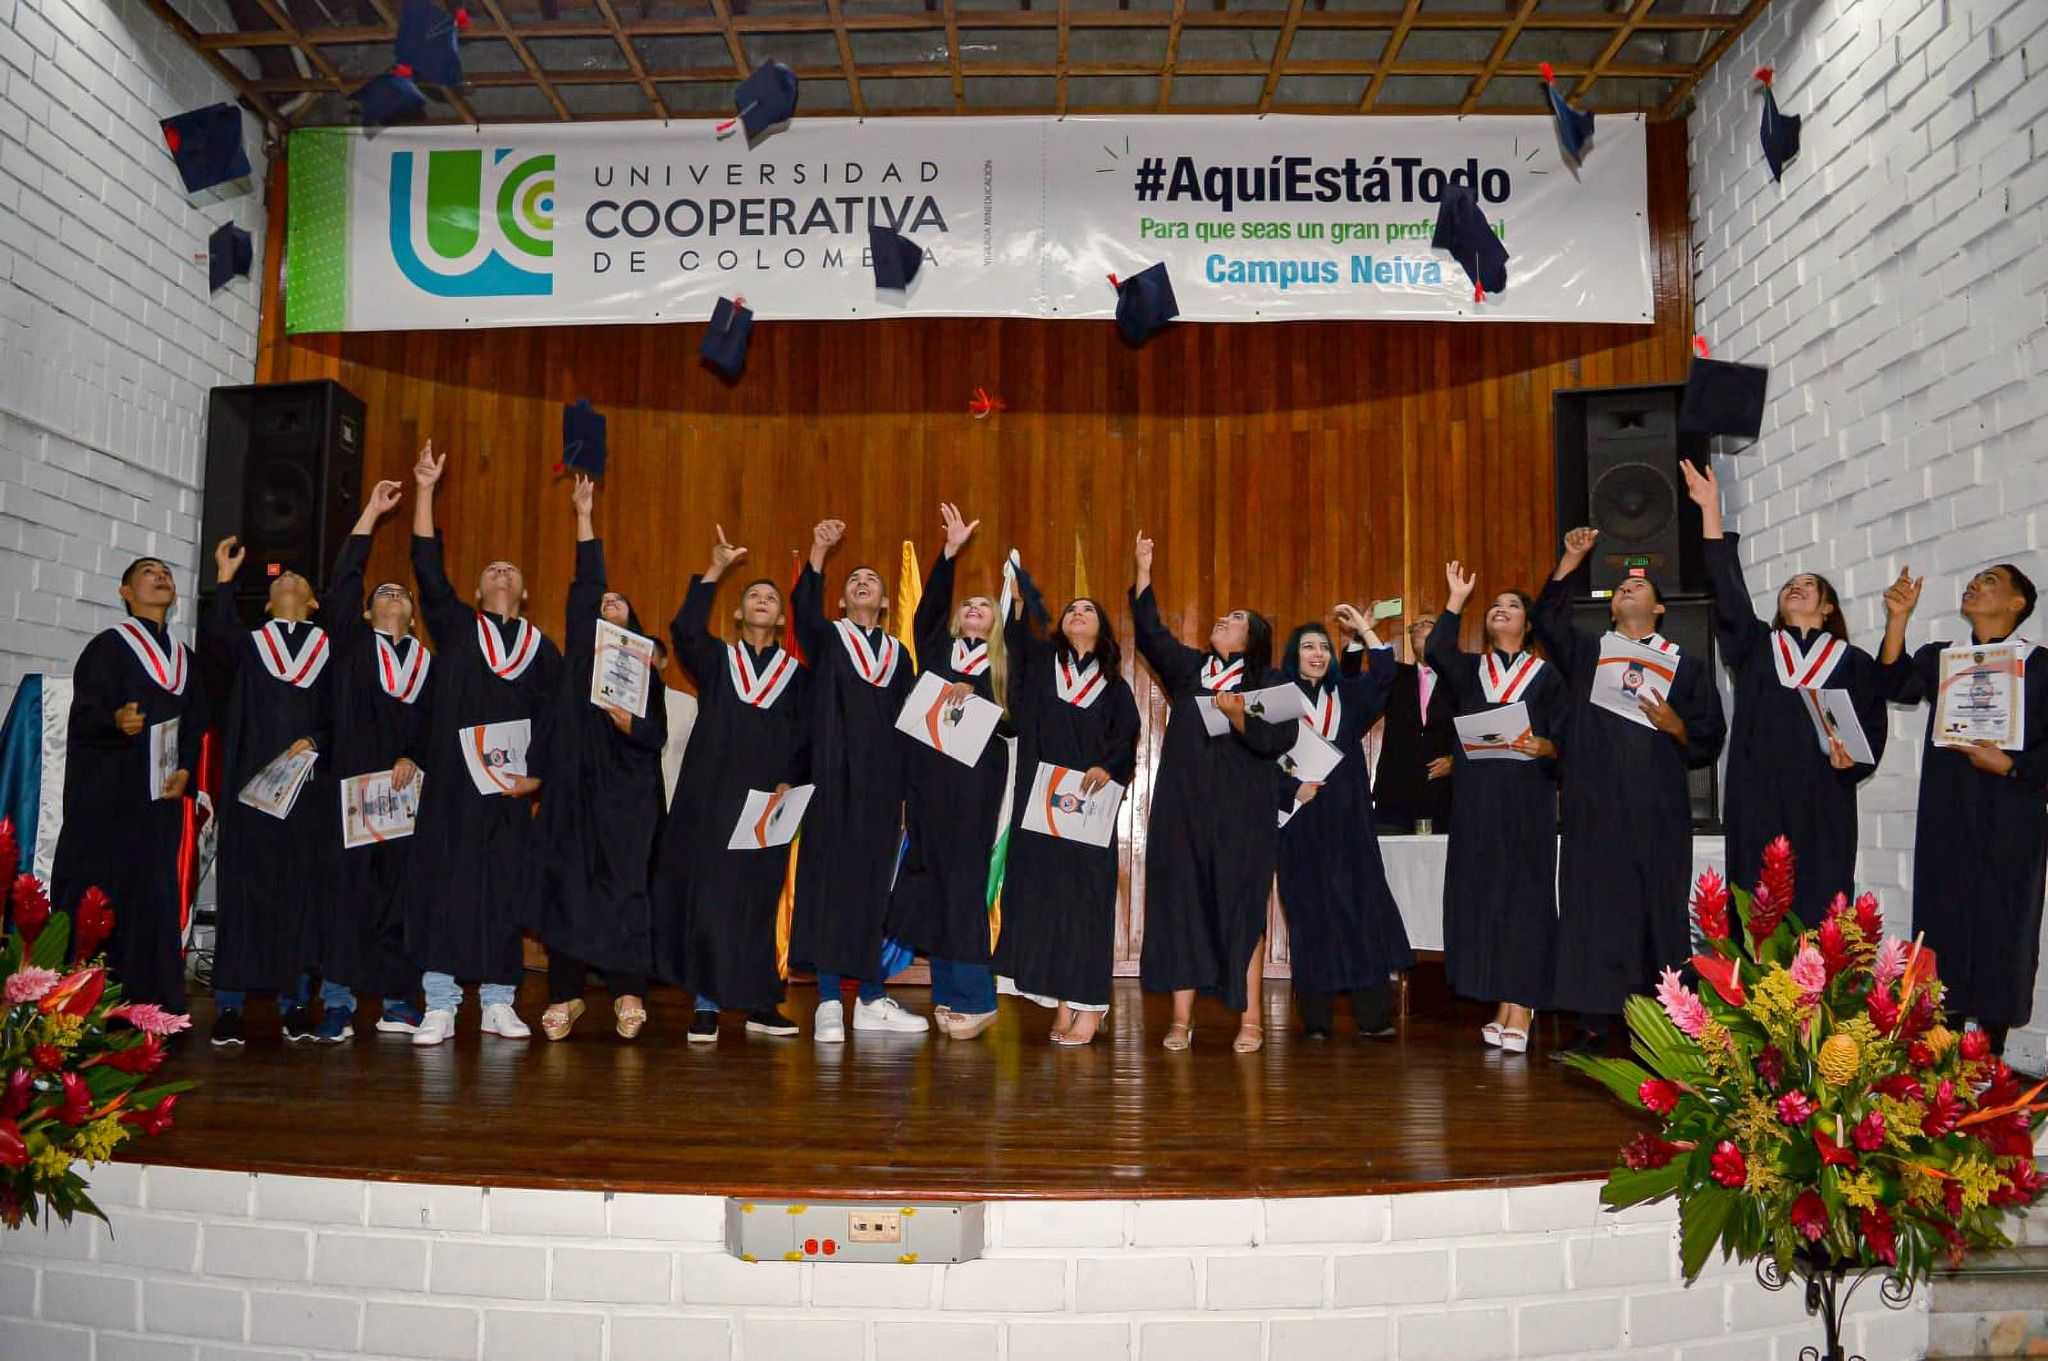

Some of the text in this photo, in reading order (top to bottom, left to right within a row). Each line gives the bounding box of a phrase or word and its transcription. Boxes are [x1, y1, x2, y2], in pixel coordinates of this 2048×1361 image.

[594, 161, 939, 187] UNIVERSIDAD
[1135, 155, 1511, 212] #AquíEstáTodo
[585, 194, 949, 239] COOPERATIVA
[1140, 218, 1189, 239] Para
[1195, 221, 1235, 244] que
[1241, 221, 1292, 239] seas
[1297, 222, 1324, 239] un
[1331, 222, 1380, 244] gran
[594, 245, 939, 273] DE COLOMBA
[1206, 254, 1441, 290] Campus Neiva
